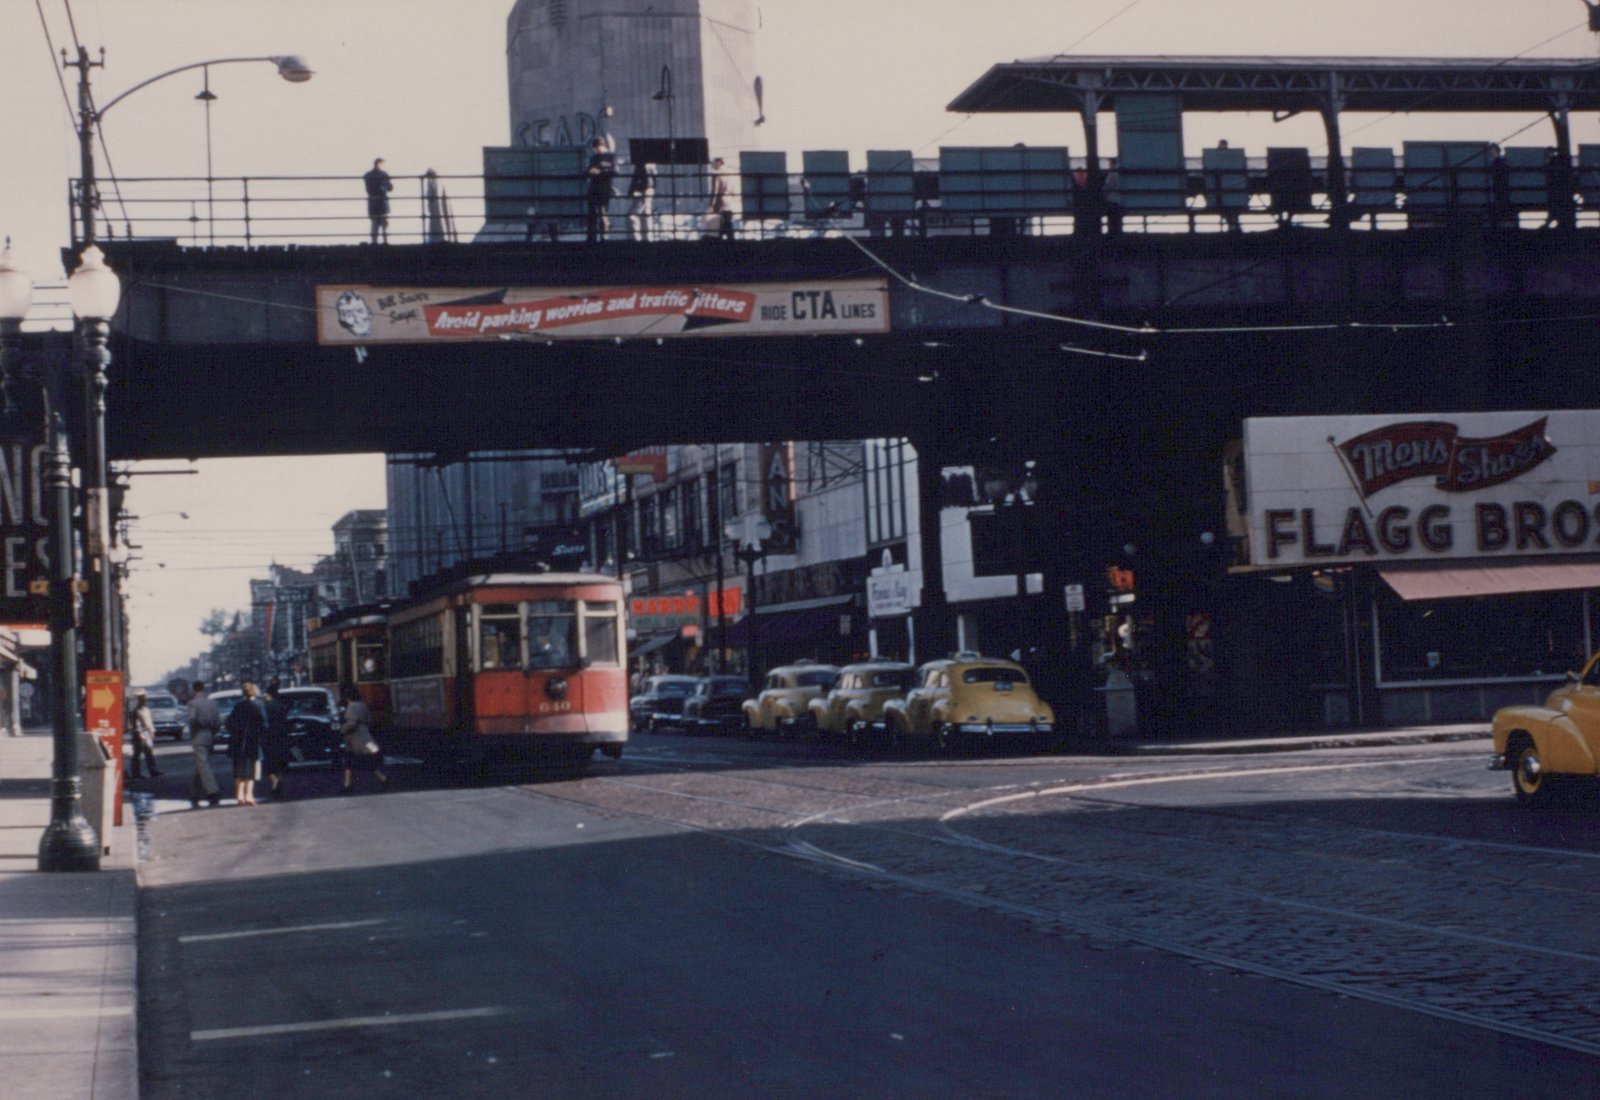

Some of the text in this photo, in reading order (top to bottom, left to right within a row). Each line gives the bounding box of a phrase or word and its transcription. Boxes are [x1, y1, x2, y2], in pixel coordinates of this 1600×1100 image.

[434, 288, 747, 333] Avoid parking worries and traffic jitters
[760, 290, 876, 321] RIDE CTA LINES
[1264, 498, 1600, 559] FLAGG BRO
